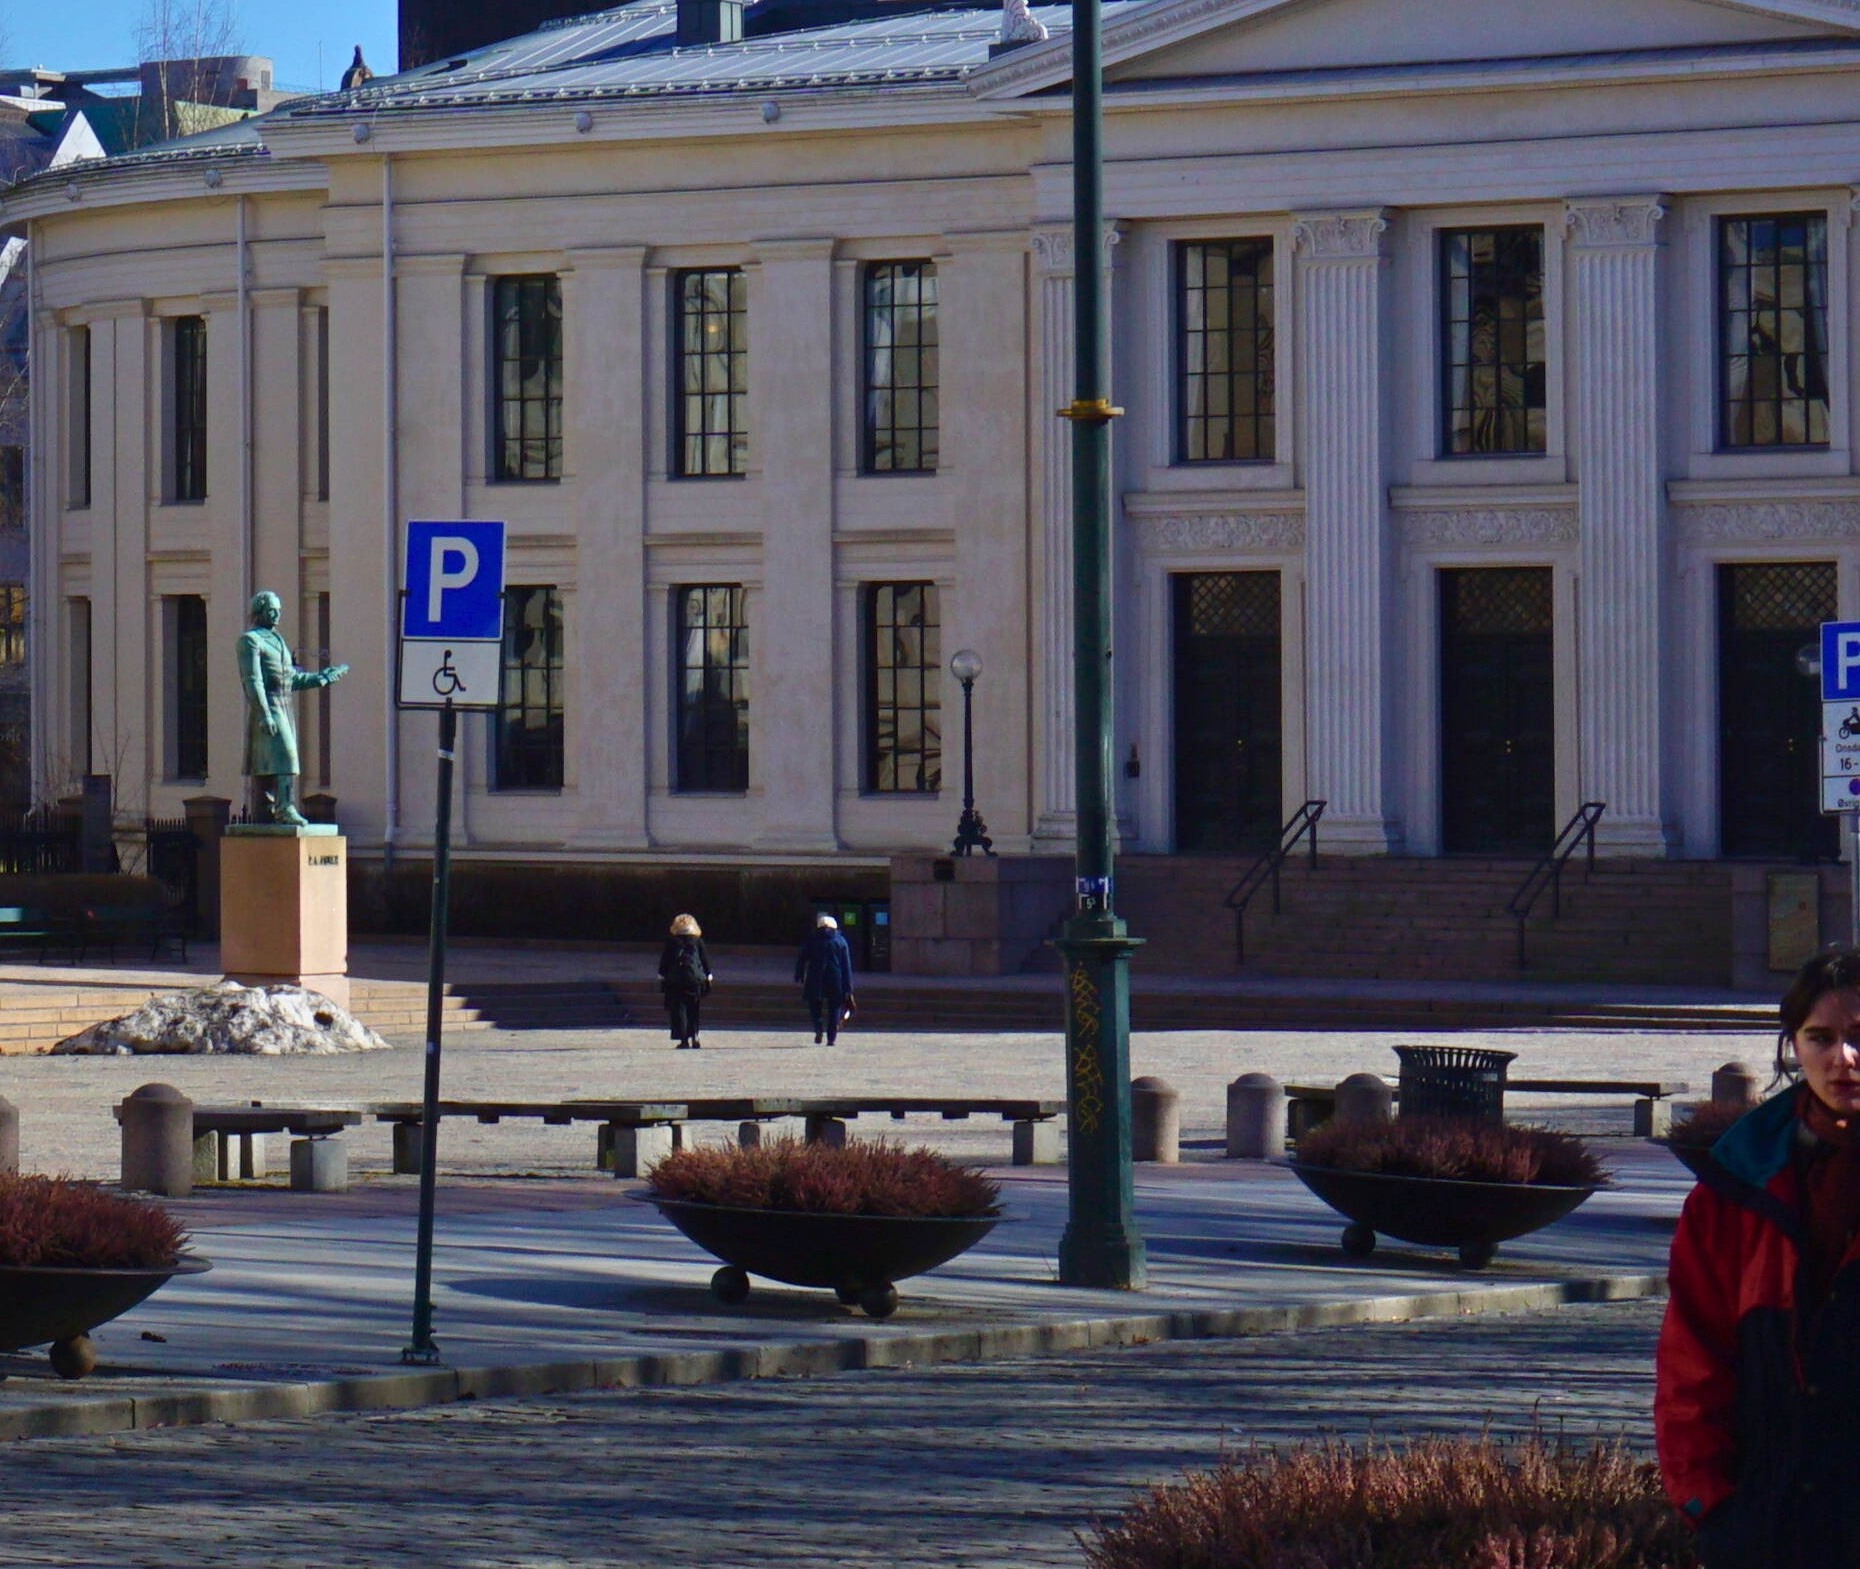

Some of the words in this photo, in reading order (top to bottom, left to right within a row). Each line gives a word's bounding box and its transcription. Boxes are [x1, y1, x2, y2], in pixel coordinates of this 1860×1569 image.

[427, 536, 480, 623] P
[1837, 632, 1860, 690] P
[1840, 757, 1852, 770] 16
